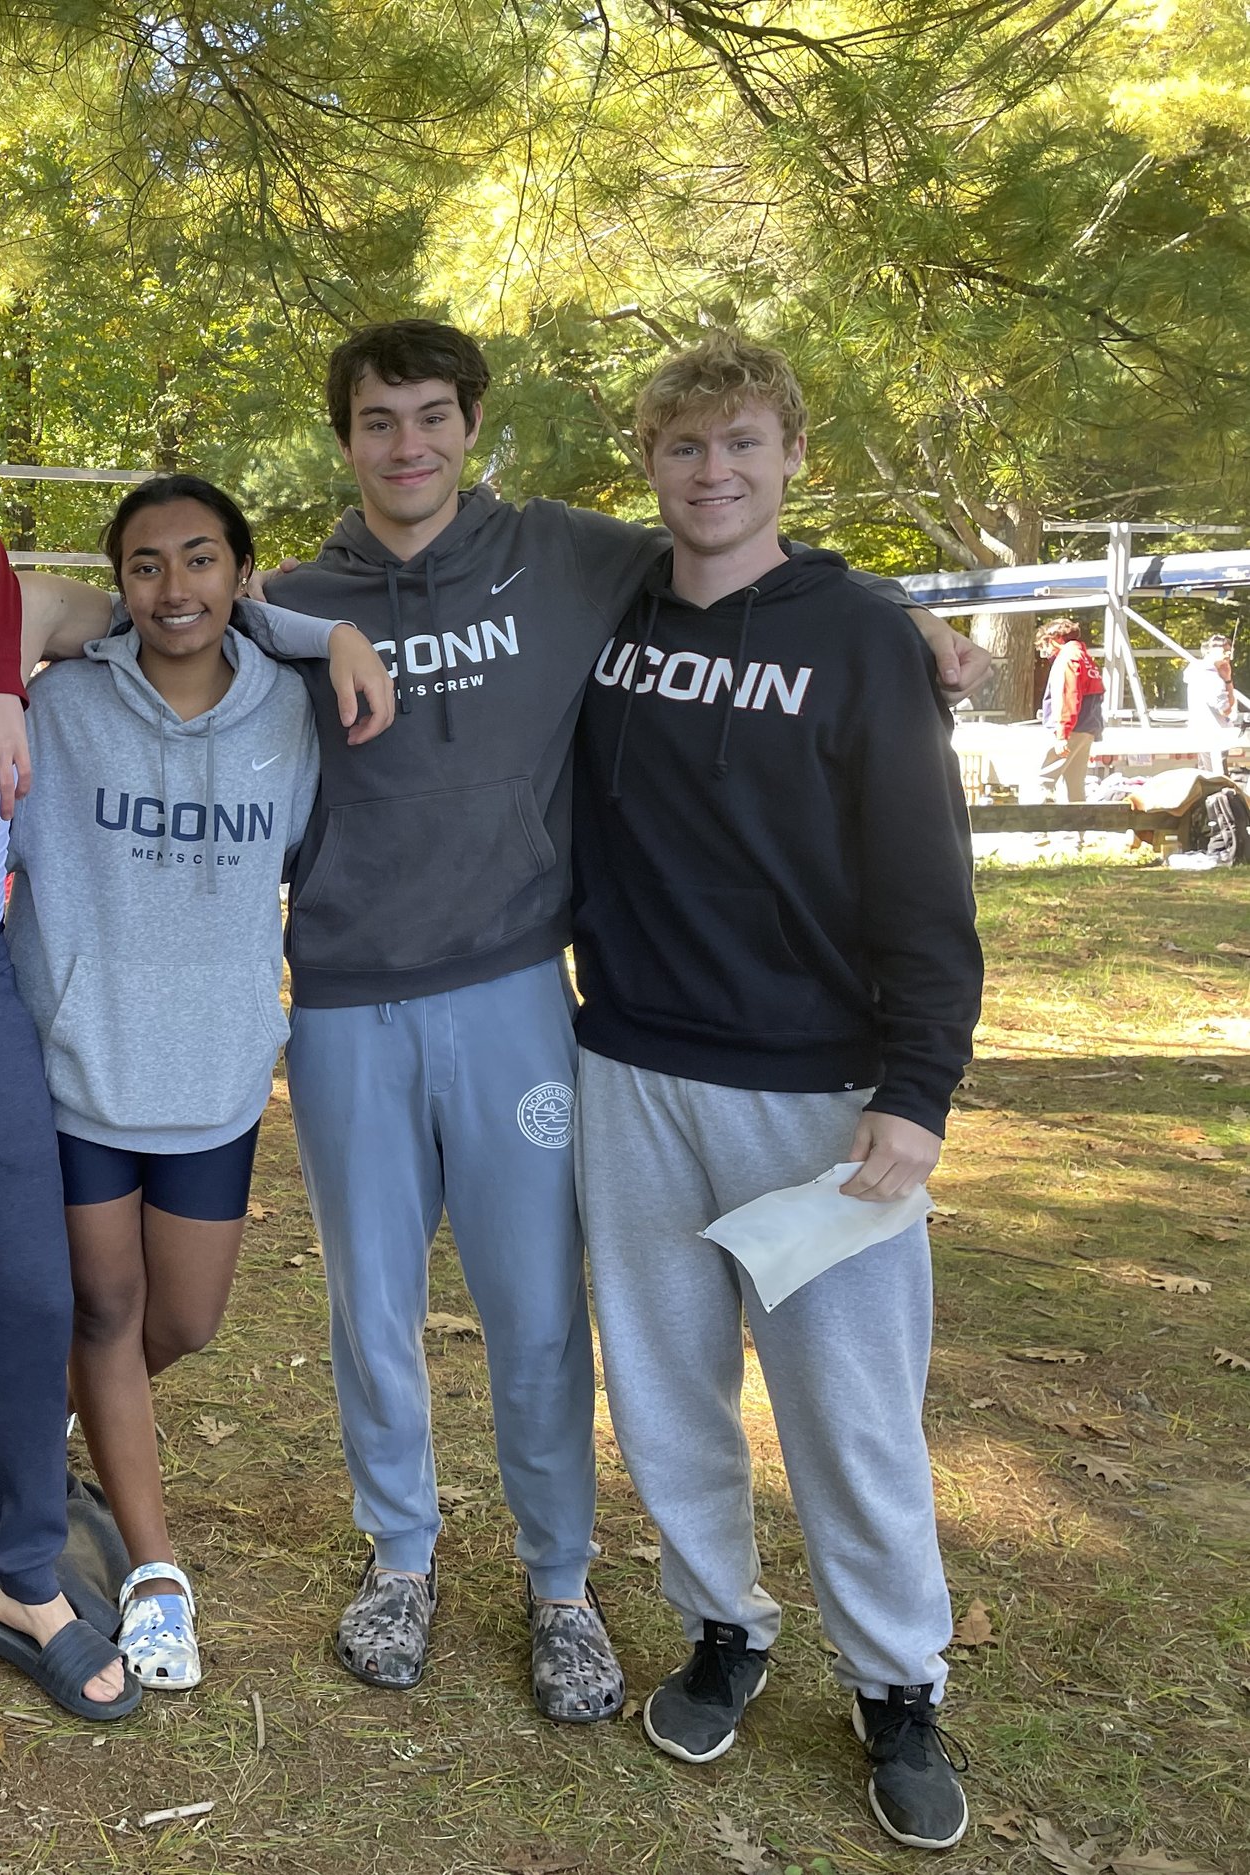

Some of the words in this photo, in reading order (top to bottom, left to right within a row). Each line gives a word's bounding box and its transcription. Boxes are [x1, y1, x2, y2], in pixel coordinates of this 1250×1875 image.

[372, 615, 520, 679] CONN
[434, 674, 484, 694] CREW
[594, 637, 813, 715] UCONN
[95, 787, 274, 842] UCONN
[193, 854, 241, 866] CEW
